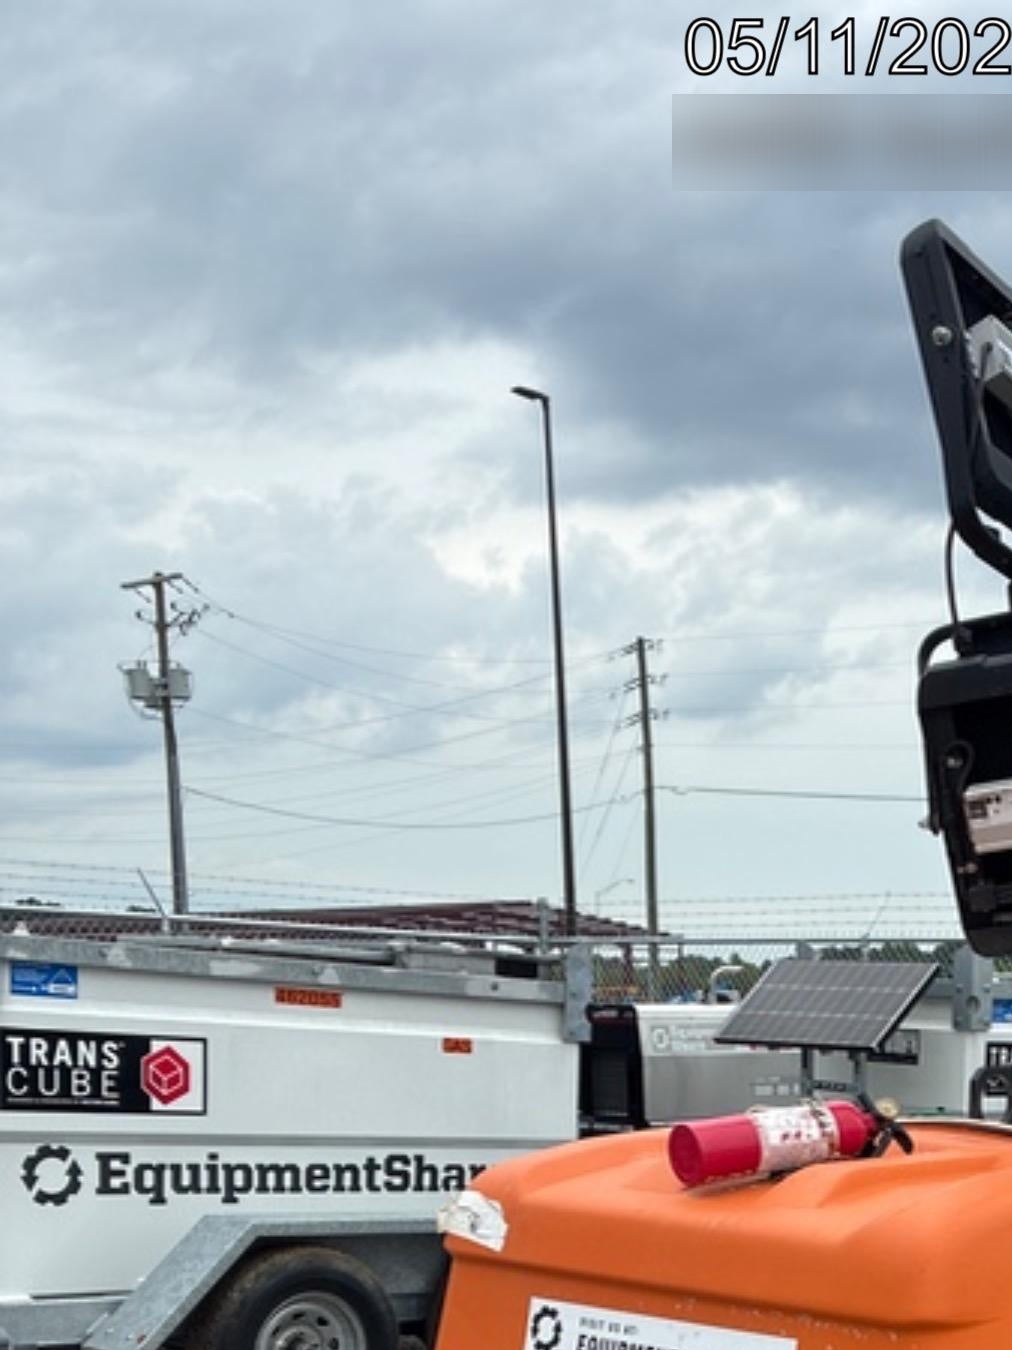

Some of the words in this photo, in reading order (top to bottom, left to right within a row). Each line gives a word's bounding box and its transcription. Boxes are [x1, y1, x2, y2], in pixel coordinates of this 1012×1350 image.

[6, 1037, 121, 1069] TRANS
[6, 1067, 121, 1100] CUBE
[95, 1152, 487, 1204] EquipmentShar
